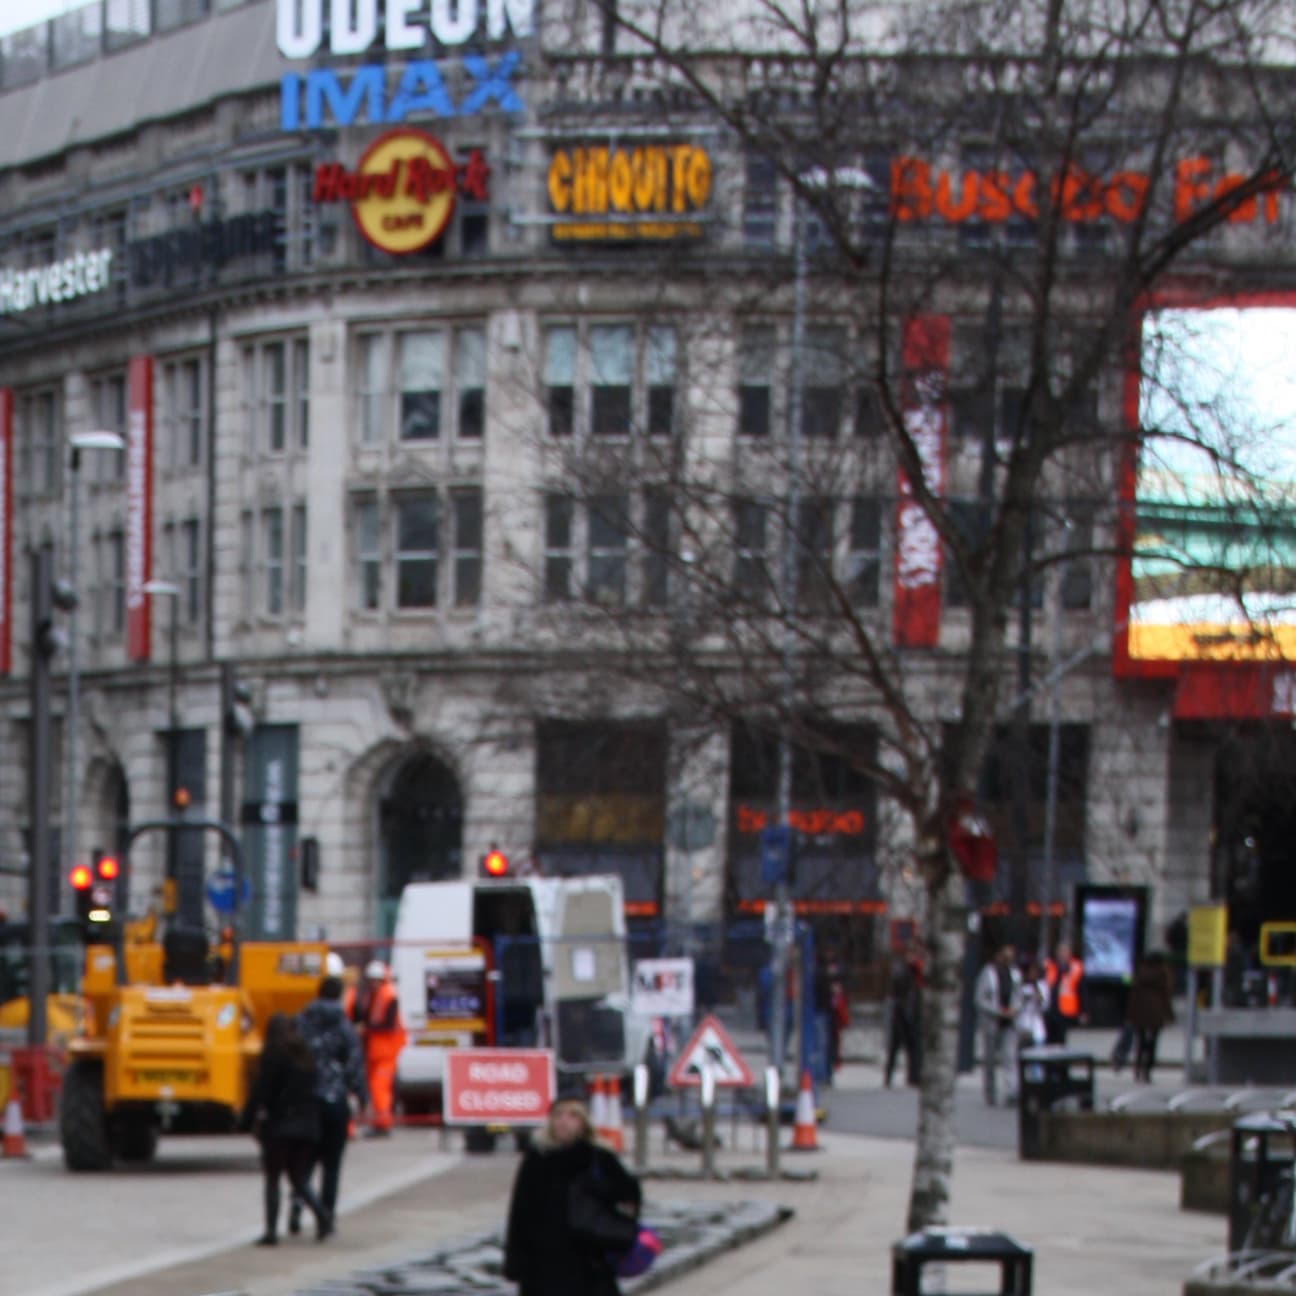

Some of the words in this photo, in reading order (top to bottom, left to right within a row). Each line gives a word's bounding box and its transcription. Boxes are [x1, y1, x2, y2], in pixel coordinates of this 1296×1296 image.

[277, 0, 535, 58] ODEON
[280, 51, 525, 132] IMAX
[313, 159, 405, 203] Hard
[547, 144, 712, 214] CHIQUITO
[468, 1061, 531, 1084] ROAD
[457, 1090, 542, 1110] CLOSED
